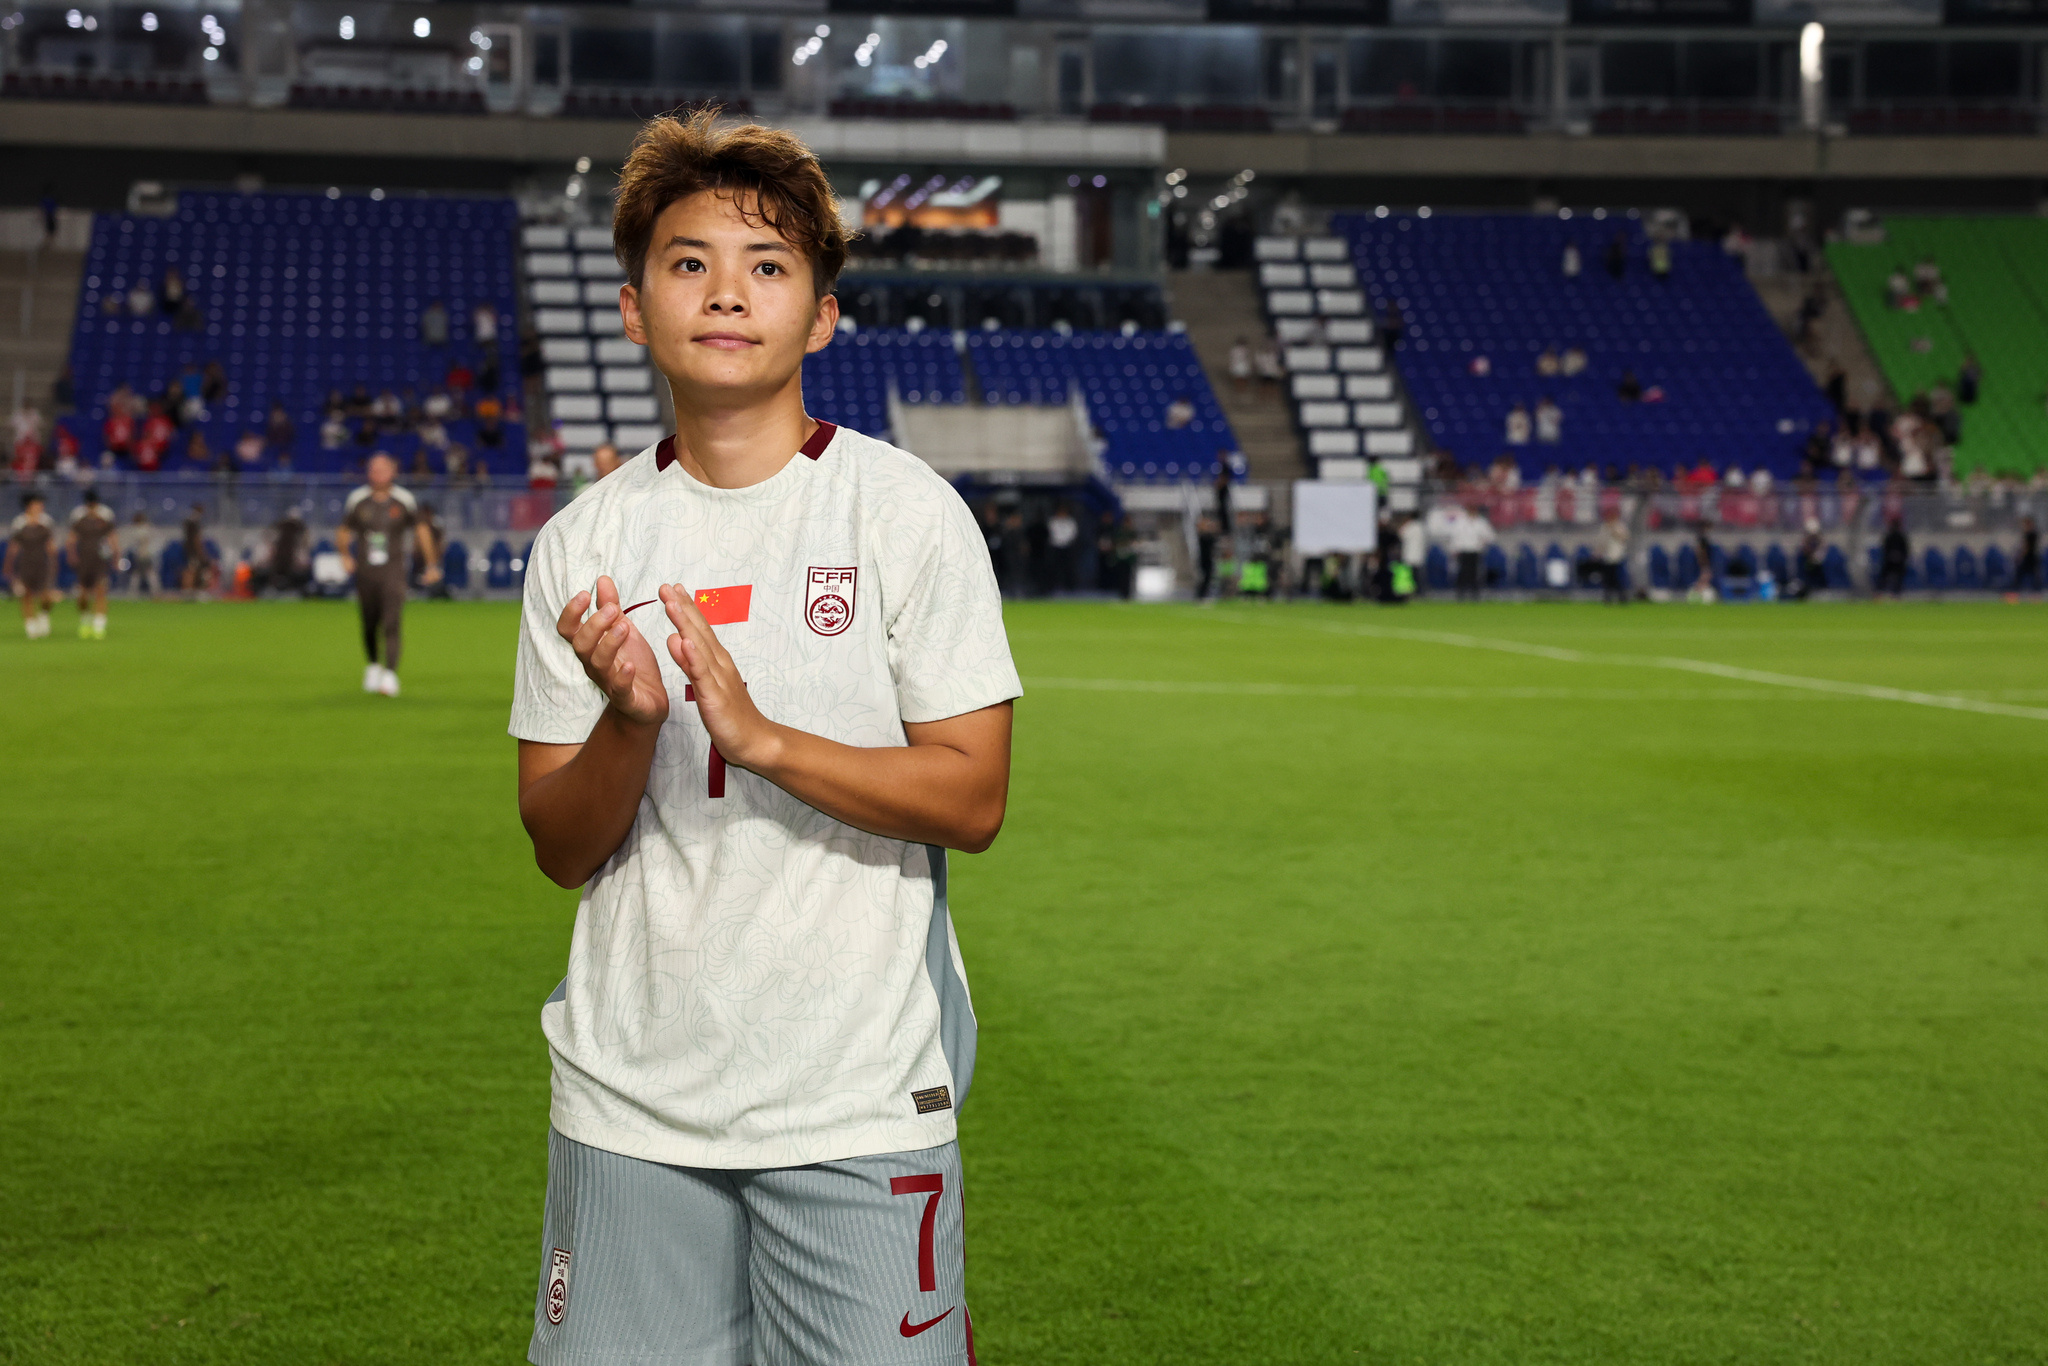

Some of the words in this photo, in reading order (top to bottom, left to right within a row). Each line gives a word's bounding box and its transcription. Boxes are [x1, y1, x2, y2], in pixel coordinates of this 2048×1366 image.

[812, 572, 852, 584] CFA
[823, 584, 840, 592] 中国
[890, 1173, 943, 1292] 7
[554, 1253, 569, 1268] CFA
